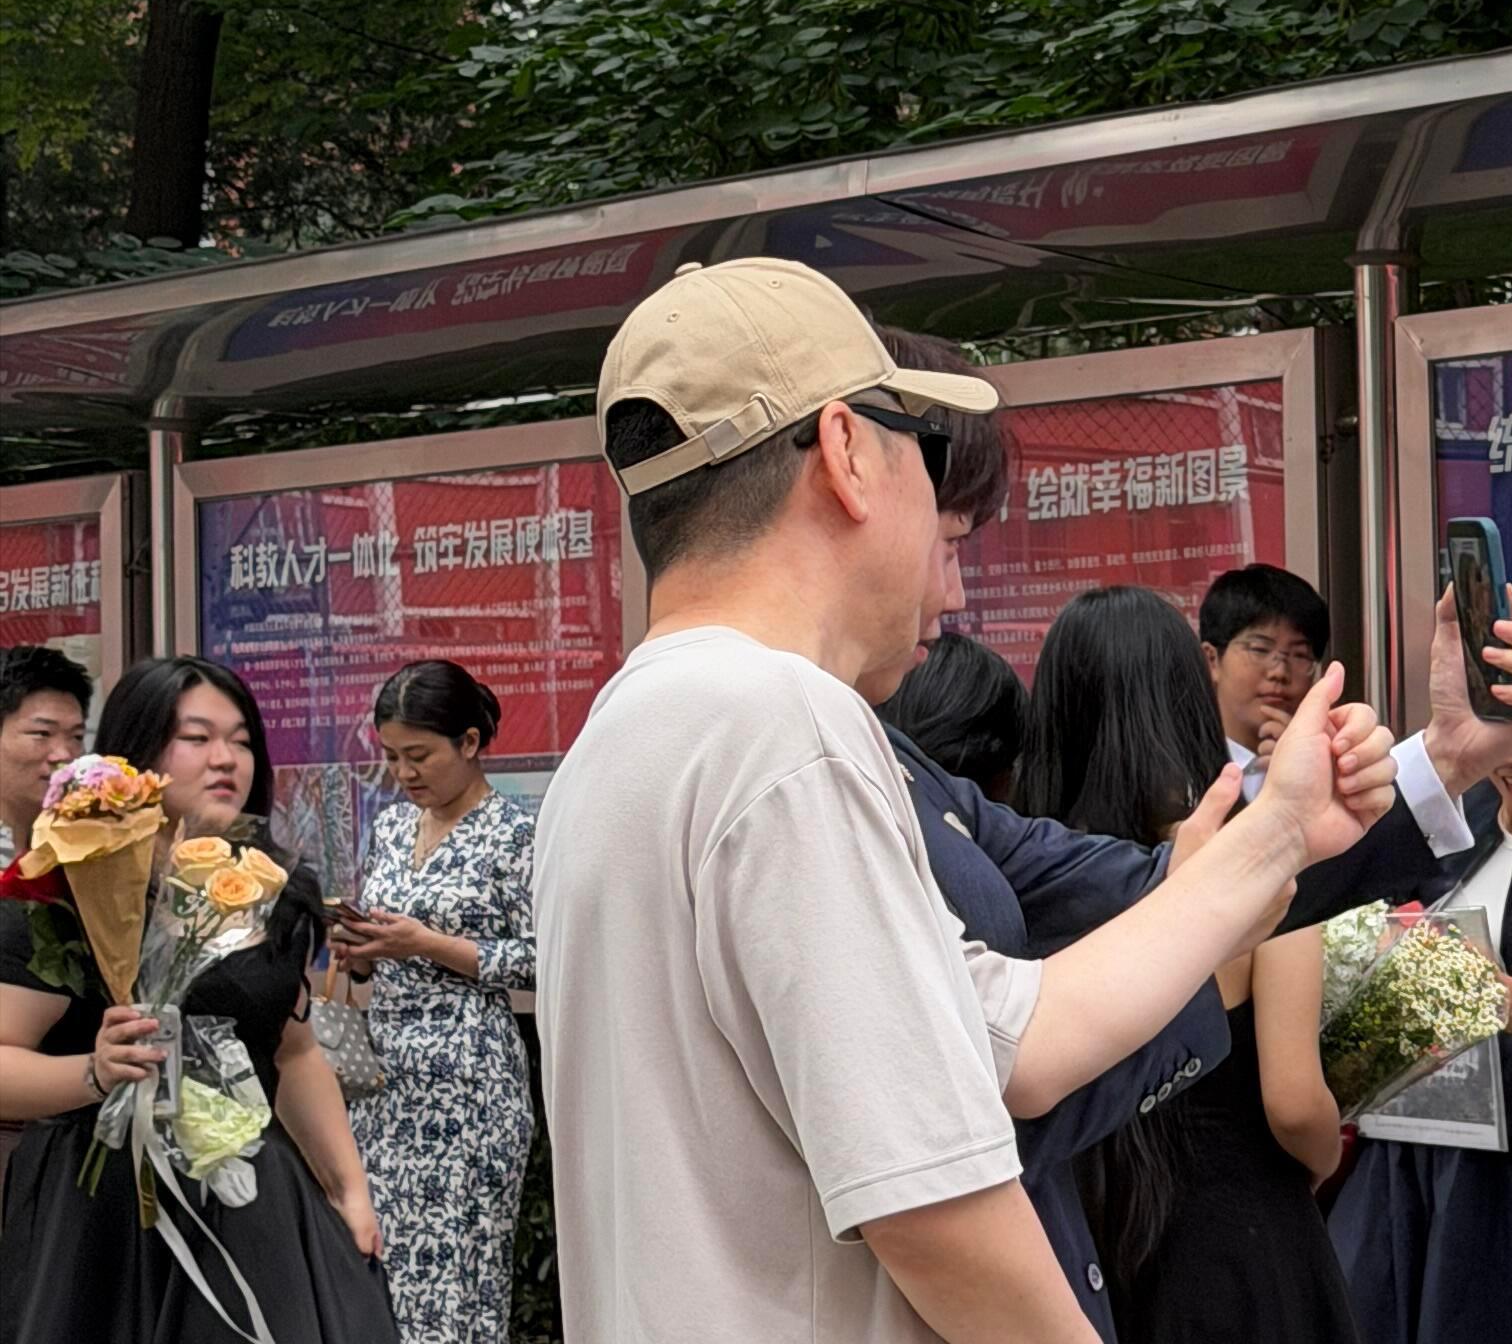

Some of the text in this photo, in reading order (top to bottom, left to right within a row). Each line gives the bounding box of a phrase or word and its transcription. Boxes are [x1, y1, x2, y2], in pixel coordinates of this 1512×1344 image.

[1027, 445, 1248, 521] 绘就幸福新图景
[230, 509, 594, 591] 科教人才一体化 筑牢发展硬根基
